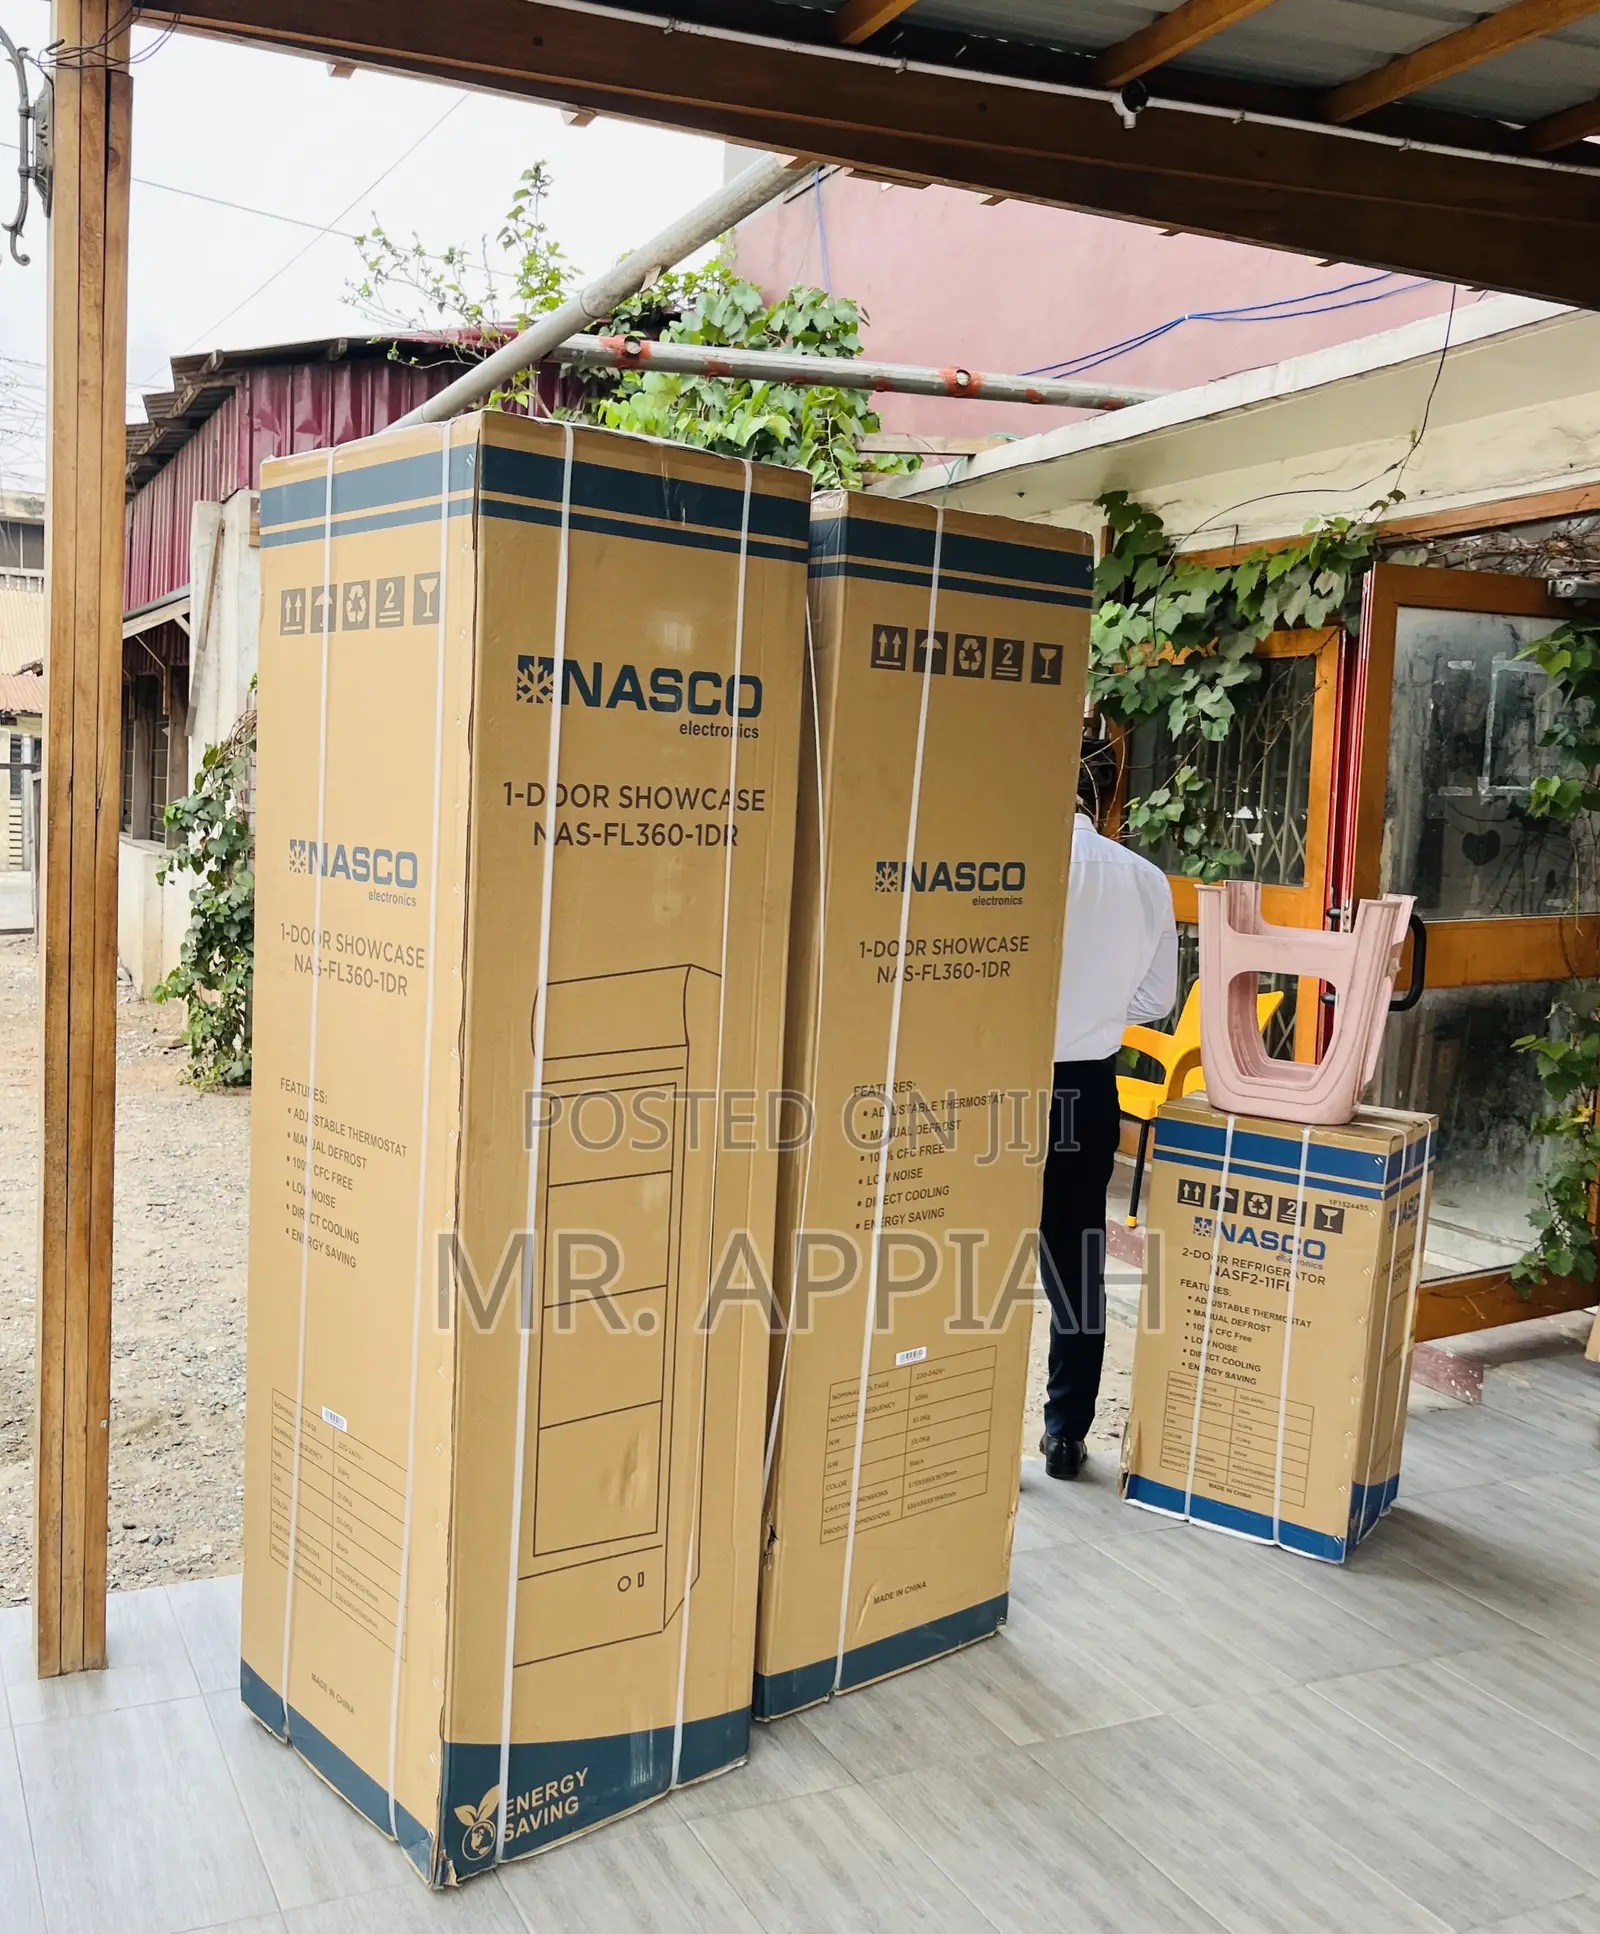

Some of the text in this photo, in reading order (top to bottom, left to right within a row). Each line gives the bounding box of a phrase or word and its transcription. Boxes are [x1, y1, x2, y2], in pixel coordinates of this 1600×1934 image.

[560, 658, 763, 718] NASCO
[619, 785, 766, 812] SHOWCASE
[308, 840, 418, 889] NASCO
[899, 861, 1026, 893] NASCO
[368, 889, 417, 907] electronics
[972, 896, 1023, 906] electronics
[335, 932, 425, 969] SHOWCASE
[859, 936, 1030, 958] 1-DOOR SHOWCASE
[280, 1077, 328, 1105] FEATUES:
[871, 1093, 1006, 1119] ADUSTABLE THERMOSTAT
[293, 1107, 408, 1158] ADJSTABLE THERMOSTAT
[916, 1119, 962, 1135] DEFROST
[327, 1144, 368, 1170] DEFROST
[868, 1143, 945, 1163] 10% CFC FREE
[313, 1164, 330, 1181] CFC
[331, 1171, 354, 1191] FREE
[892, 1167, 924, 1182] NOISE
[311, 1188, 337, 1209] NOISE
[865, 1185, 950, 1208] DIECT COOLING
[291, 1203, 360, 1244] DIRCT COOLING
[908, 1207, 945, 1223] SAVING
[291, 1227, 357, 1269] ENRGY SAVING
[1213, 1219, 1327, 1261] NASCO
[1194, 1296, 1250, 1315] ADUSTABLE
[1215, 1327, 1233, 1338] CFC
[1234, 1332, 1253, 1343] Free
[1231, 1317, 1272, 1333] DEFROST
[1211, 1340, 1238, 1353] NOISE
[1188, 1362, 1257, 1386] ENRGY SAVING
[1222, 1356, 1262, 1373] COOLING
[873, 1580, 927, 1605] MADE IN CHINA
[505, 1767, 588, 1819] ENERGY
[503, 1795, 580, 1843] SAVING
